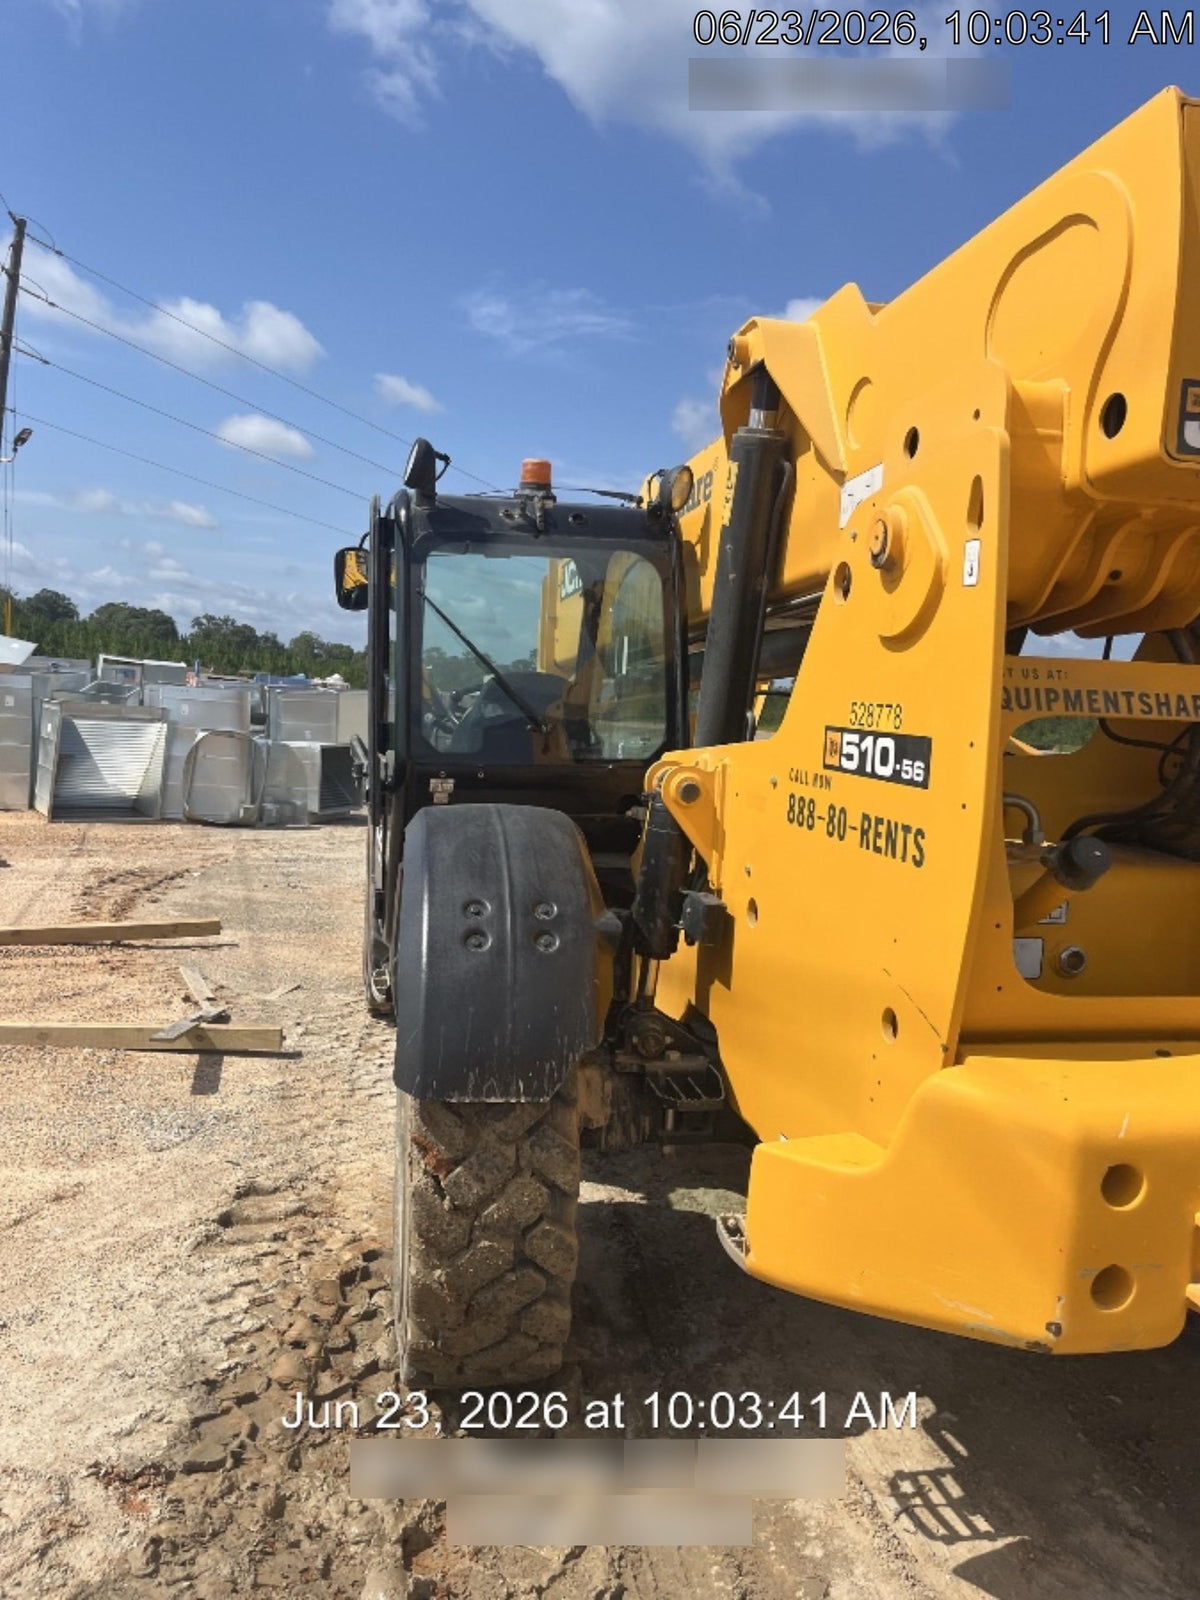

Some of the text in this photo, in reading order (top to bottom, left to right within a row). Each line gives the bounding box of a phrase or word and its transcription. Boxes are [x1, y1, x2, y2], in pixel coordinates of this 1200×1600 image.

[1021, 667, 1040, 680] US
[849, 702, 903, 730] 528778
[789, 767, 809, 786] CALL
[787, 792, 926, 868] 888-80-RENTS
